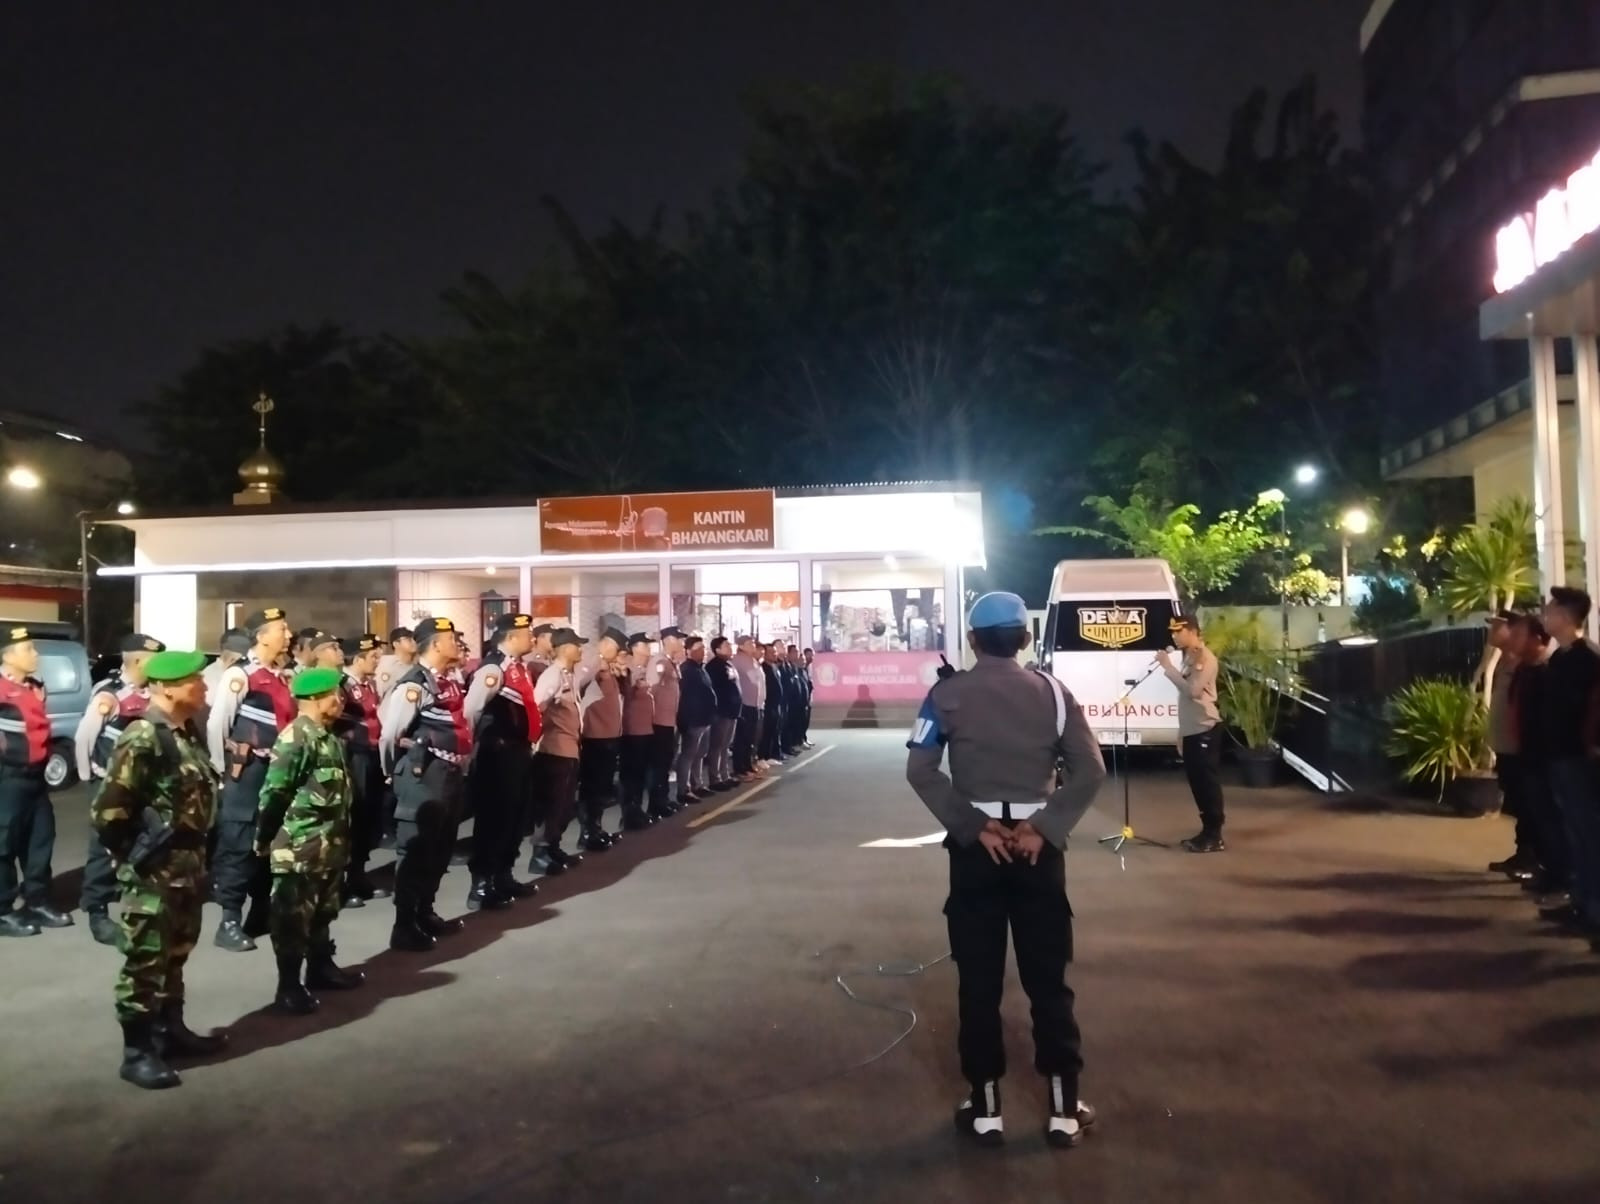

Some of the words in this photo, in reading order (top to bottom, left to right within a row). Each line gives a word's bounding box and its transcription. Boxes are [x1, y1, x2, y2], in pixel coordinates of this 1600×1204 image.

[693, 510, 745, 525] KANTIN
[671, 528, 769, 545] BHAYANGKARI
[1082, 610, 1141, 624] DEWA
[1093, 626, 1132, 640] UNITED
